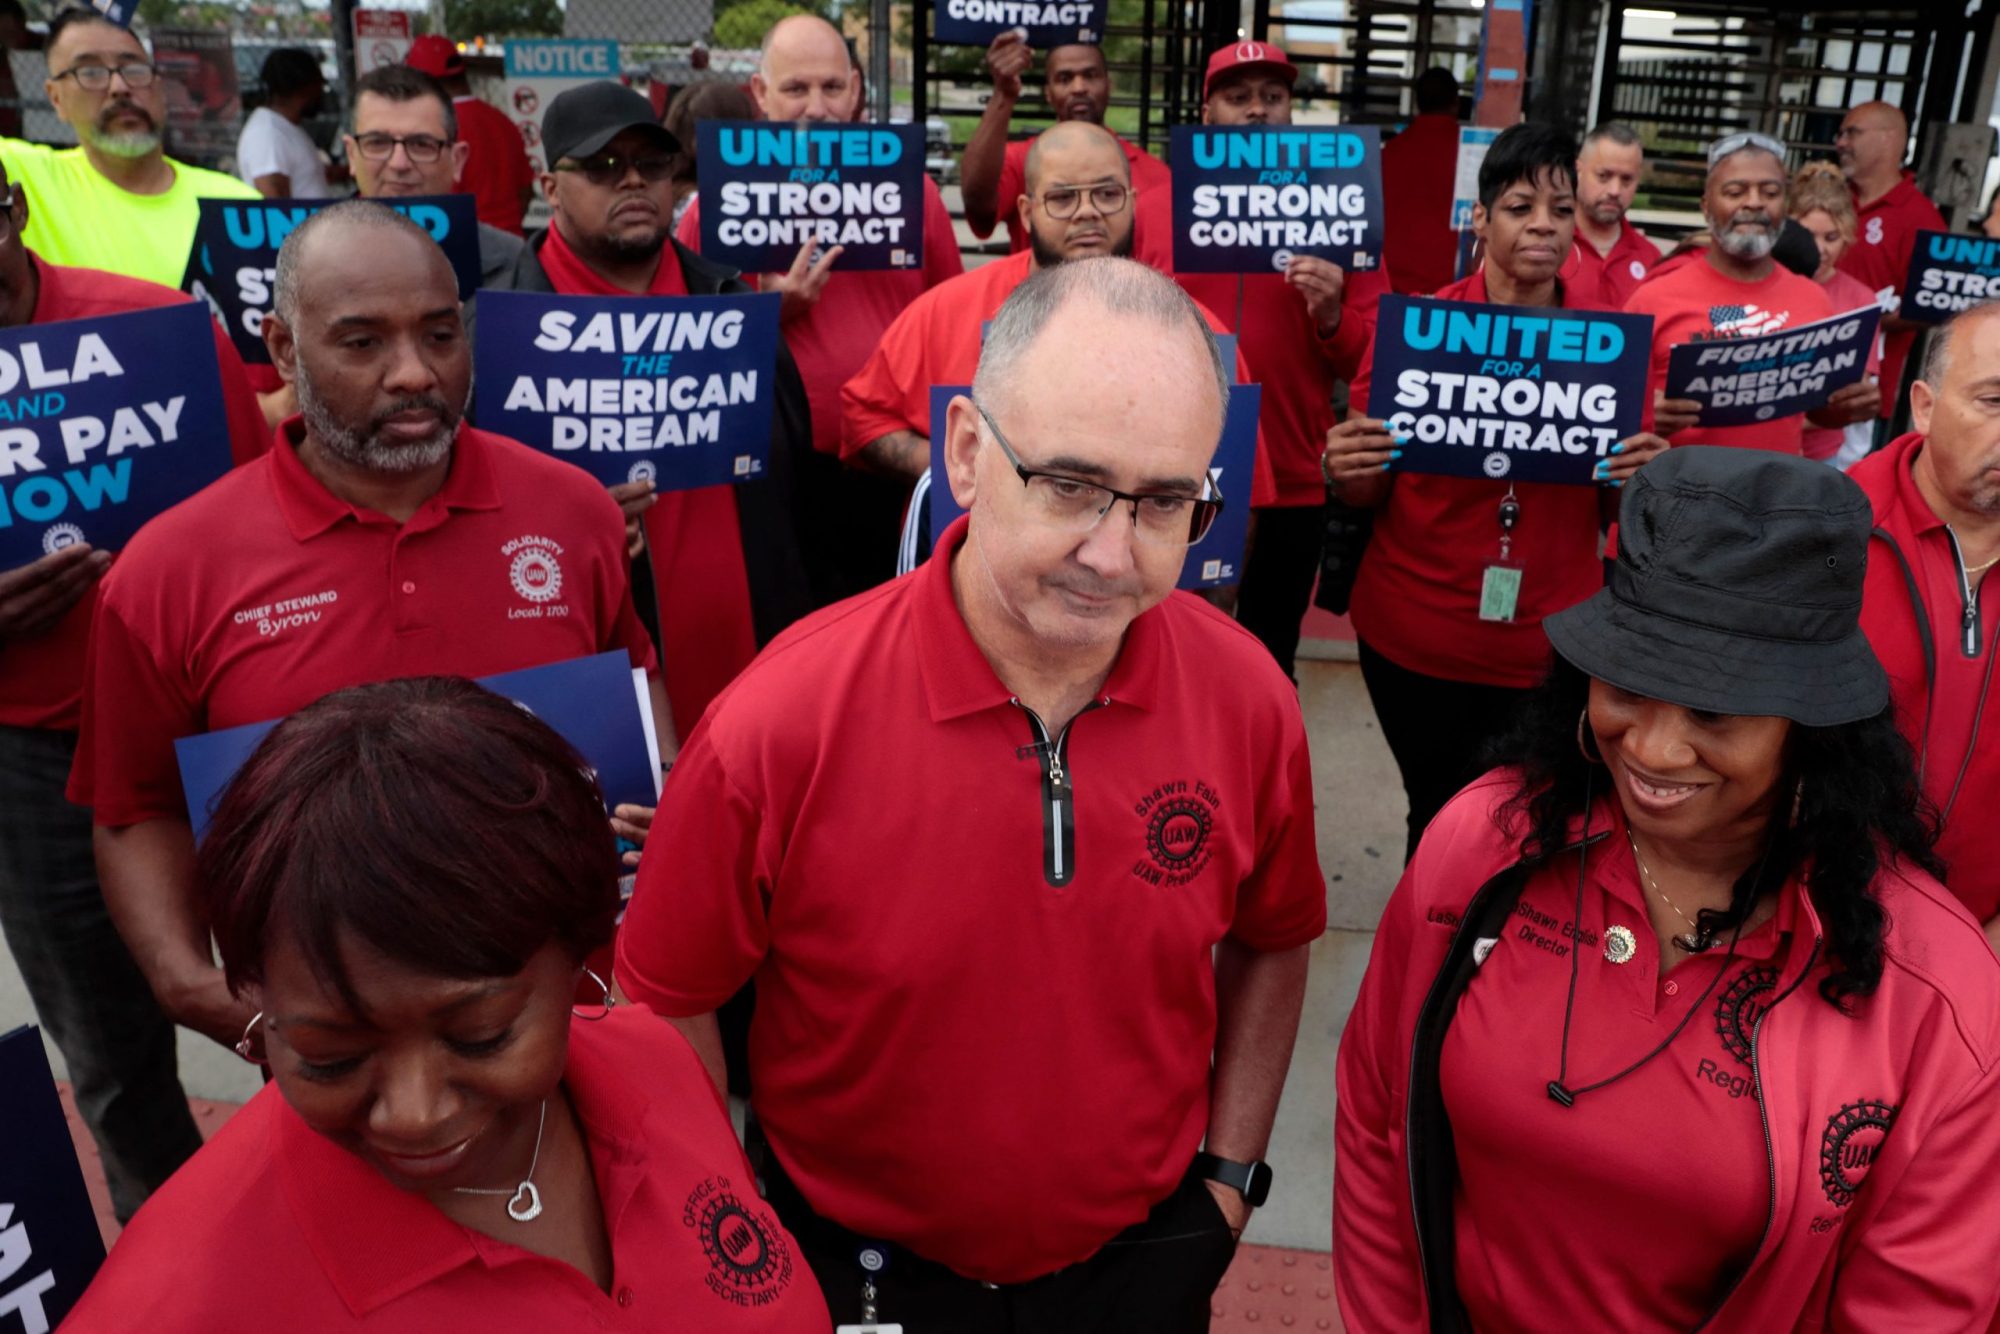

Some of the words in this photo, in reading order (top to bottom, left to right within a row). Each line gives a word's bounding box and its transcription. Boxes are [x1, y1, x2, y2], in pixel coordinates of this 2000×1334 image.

[947, 3, 1094, 26] CONTRACT
[513, 44, 609, 73] NOTICE
[719, 128, 902, 167] UNITED
[1192, 132, 1365, 169] UNITED
[789, 168, 825, 183] FOR
[829, 169, 840, 183] A
[1258, 171, 1292, 185] FOR
[1295, 171, 1308, 184] A
[720, 181, 901, 216] STRONG
[1192, 184, 1365, 217] STRONG
[718, 218, 905, 246] CONTRACT
[1189, 220, 1368, 247] CONTRACT
[1929, 235, 2000, 266] UNI
[534, 309, 745, 353] SAVING
[1403, 306, 1625, 364] UNITED
[1696, 319, 1862, 366] FIGHTING
[622, 354, 672, 377] THE
[1480, 359, 1524, 378] FOR
[1526, 363, 1542, 379] A
[1685, 349, 1857, 393] AMERICAN
[1737, 358, 1776, 374] FOR
[503, 370, 757, 415] AMERICAN
[1394, 368, 1617, 423] STRONG
[1711, 374, 1826, 408] DREAM
[59, 395, 186, 465] PAY
[552, 410, 721, 452] DREAM
[1389, 411, 1618, 456] CONTRACT
[501, 535, 564, 556] SOLIDARITY
[527, 569, 546, 582] UAW
[234, 604, 272, 624] CHIEF
[275, 590, 337, 614] STEWARD
[256, 610, 322, 637] Byron
[508, 606, 543, 619] Local
[547, 605, 569, 617] 1700
[1134, 780, 1187, 818] Shawn
[1195, 780, 1220, 810] Fain
[1164, 826, 1198, 845] UAW
[1132, 860, 1164, 887] UAW
[1518, 924, 1570, 959] Director
[683, 1179, 717, 1228] OFFICE
[723, 1222, 753, 1258] UAW
